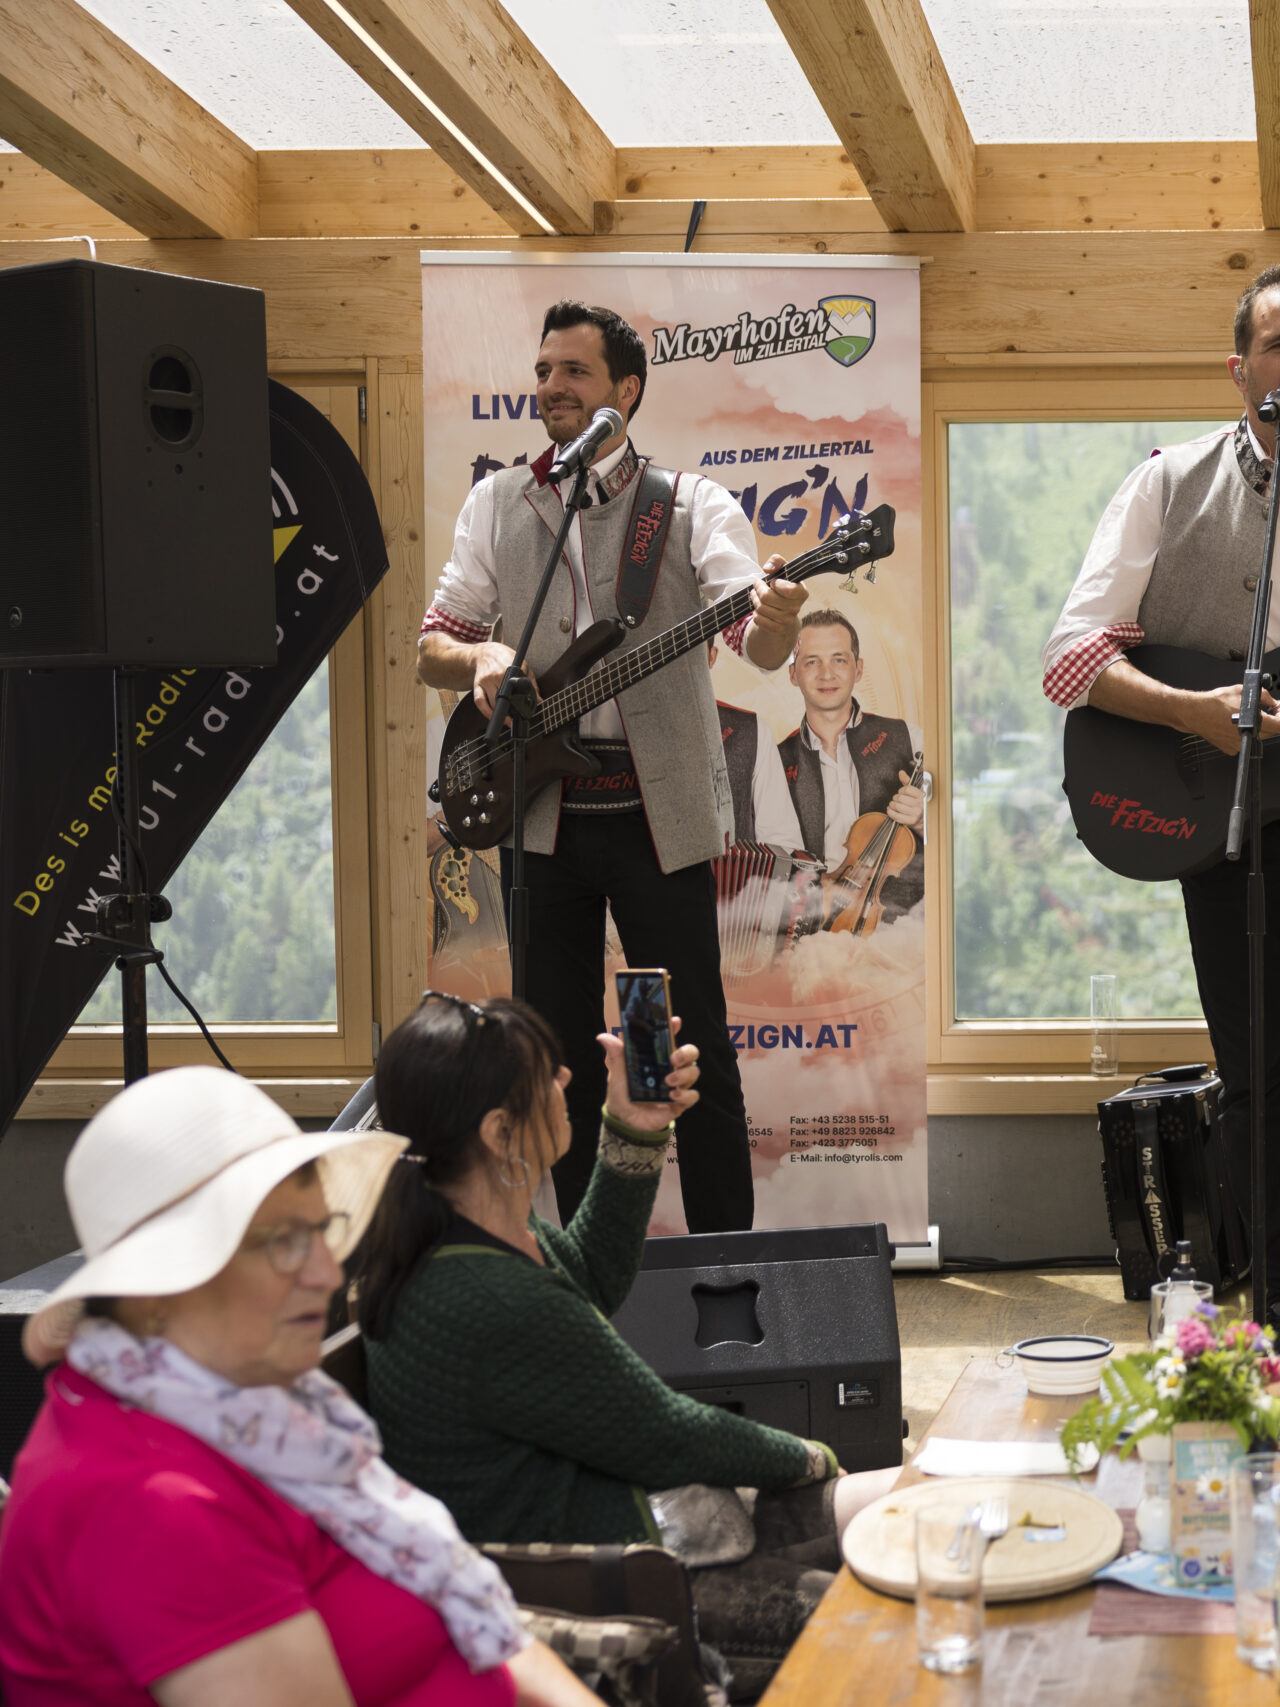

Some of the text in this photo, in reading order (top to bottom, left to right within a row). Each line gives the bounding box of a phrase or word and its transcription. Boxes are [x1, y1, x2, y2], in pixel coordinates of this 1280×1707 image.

[652, 304, 829, 364] Mayrhofen
[735, 332, 828, 364] IM ZILLERTAL
[700, 440, 874, 467] AUS DEM ZILLERTAL
[650, 501, 665, 520] DIE
[1089, 791, 1197, 839] DIE FETZIG'N
[13, 855, 66, 916] Des
[58, 819, 90, 848] is
[729, 1024, 858, 1049] ZIGN.AT
[790, 1115, 889, 1124] Fax: +43 5238 515-51
[790, 1127, 896, 1136] Fax: +49 8823 926842
[790, 1138, 878, 1148] Fax: +423 3775051
[790, 1152, 903, 1164] E-Mail: info@tyrolis.com
